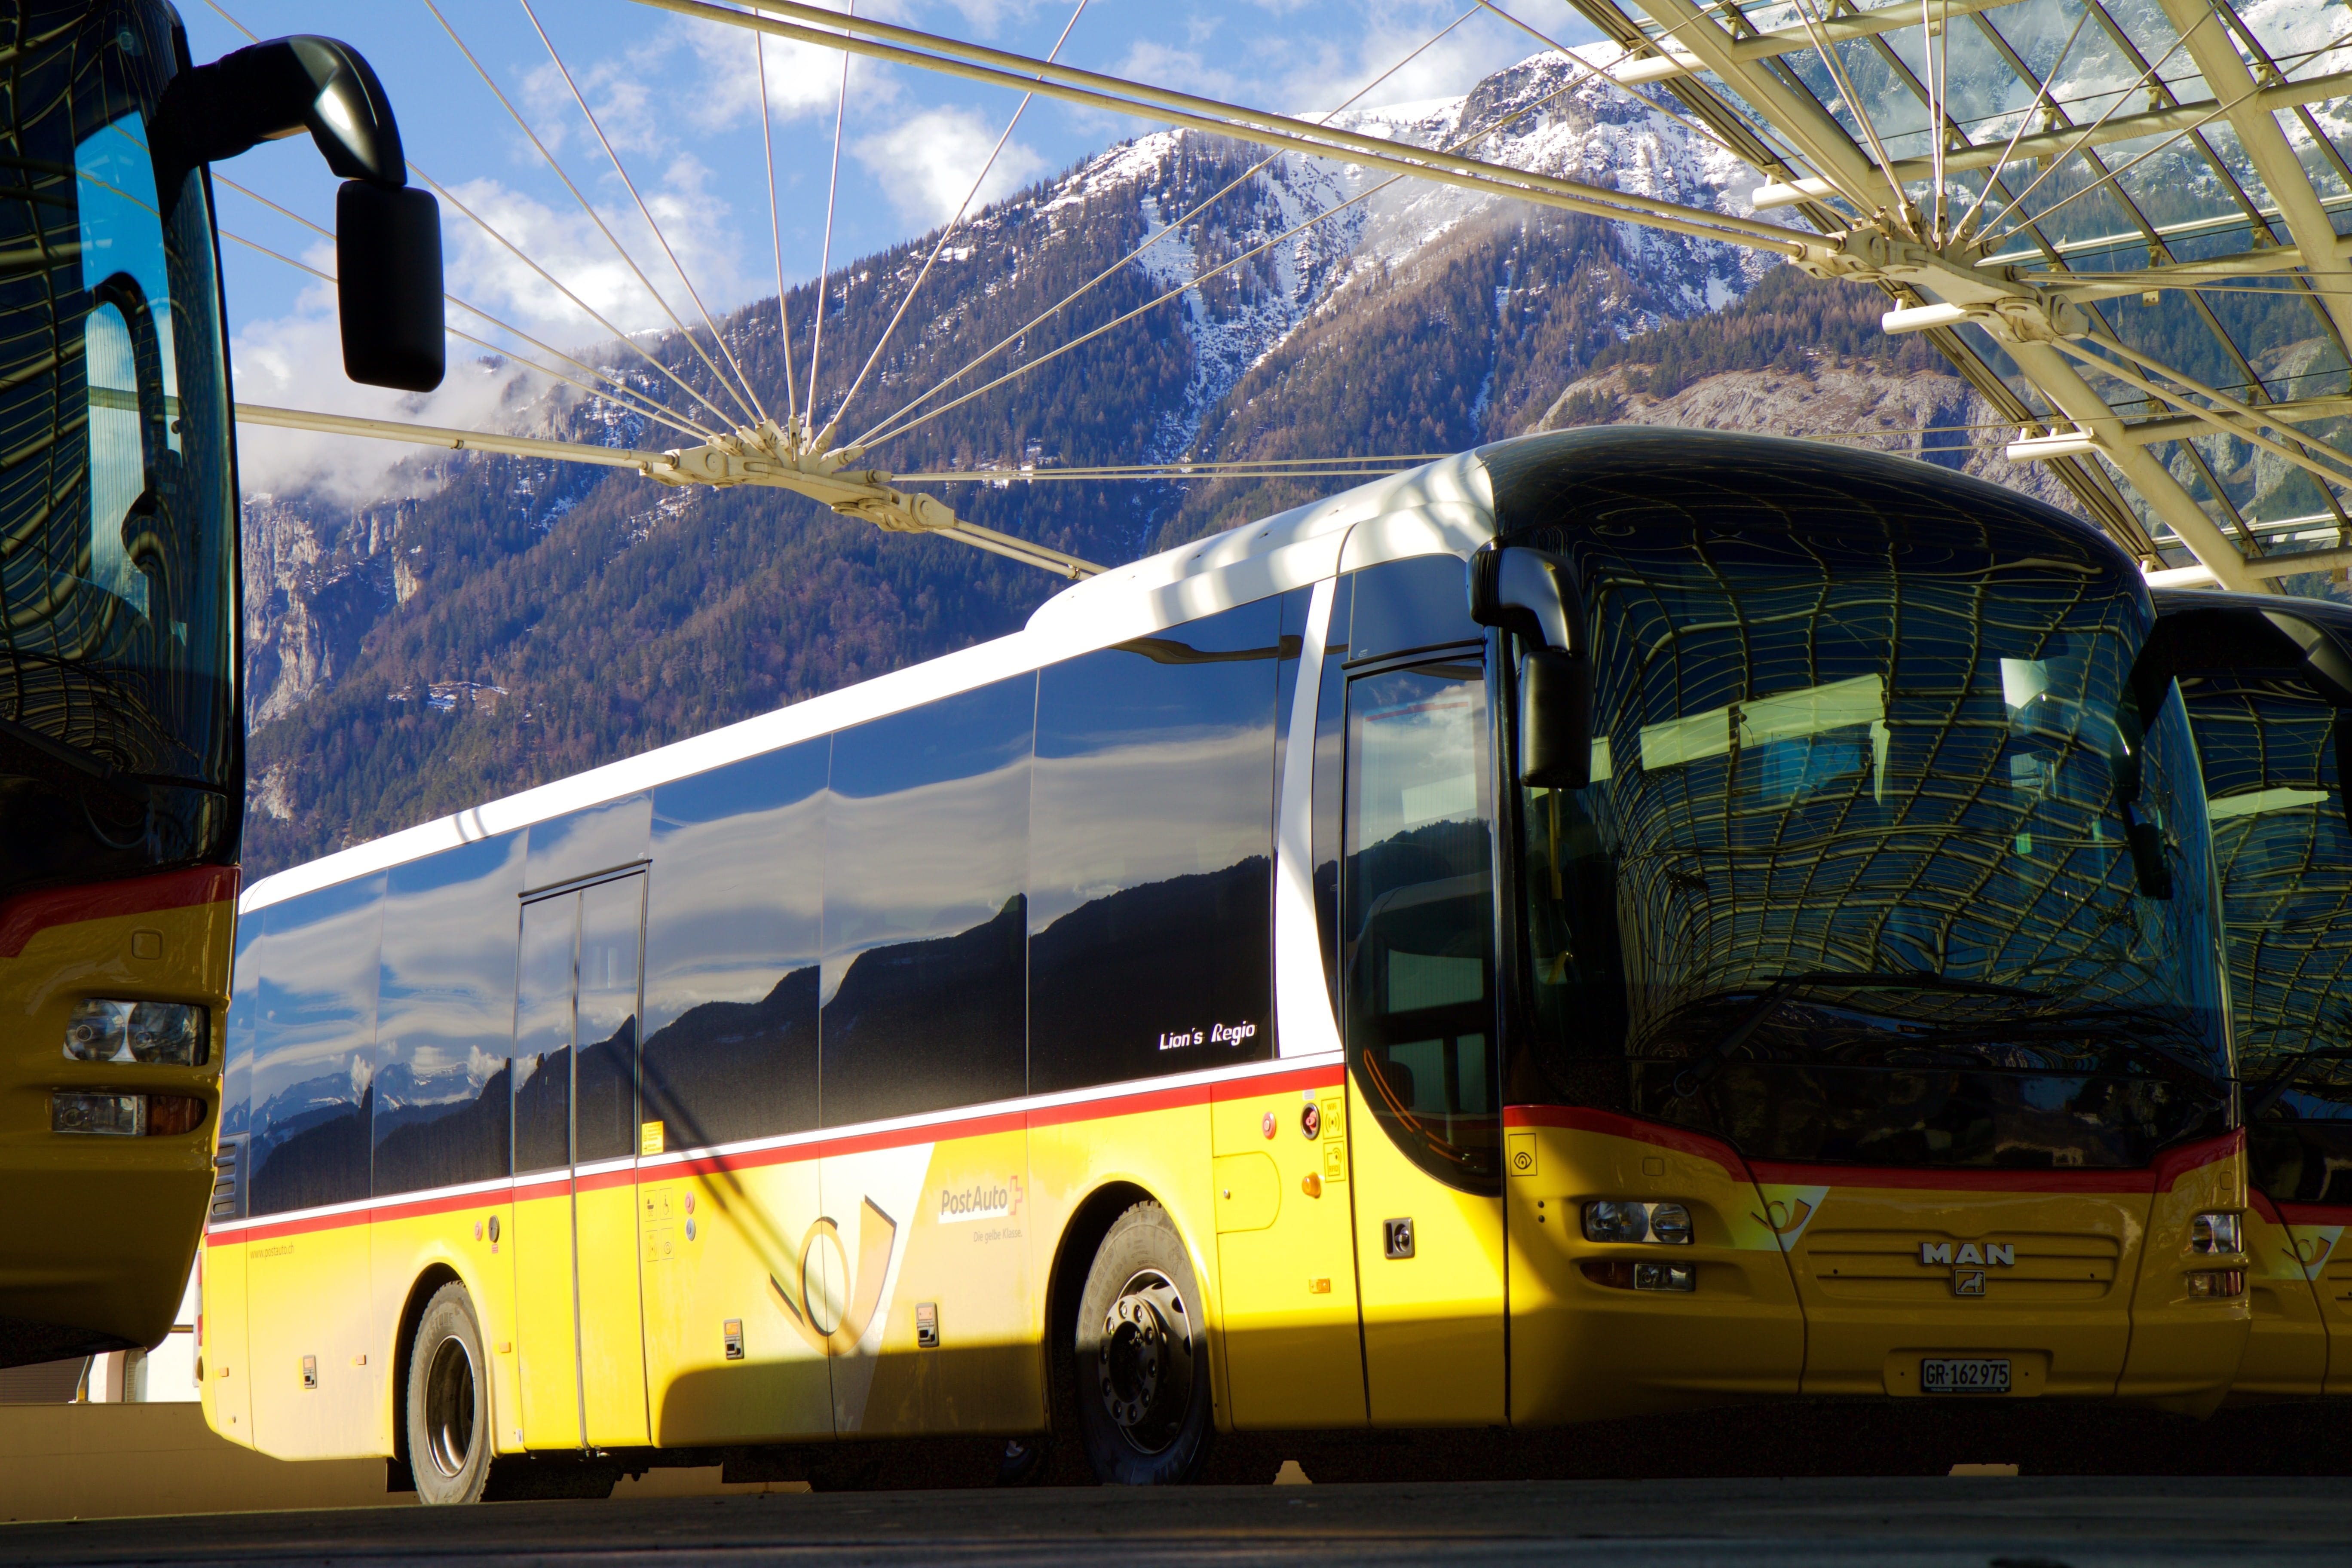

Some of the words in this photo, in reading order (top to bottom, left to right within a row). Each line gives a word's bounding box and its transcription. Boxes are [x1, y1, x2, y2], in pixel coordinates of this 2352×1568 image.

[1159, 1028, 1203, 1050] Lion's
[1211, 1021, 1256, 1046] Regio
[941, 1185, 1008, 1216] PostAuto
[974, 1232, 983, 1242] Die
[985, 1230, 1001, 1243] gelbe
[1002, 1228, 1023, 1239] Klasse.
[250, 1242, 294, 1260] www.postauto.ch
[1922, 1243, 2015, 1265] MAN
